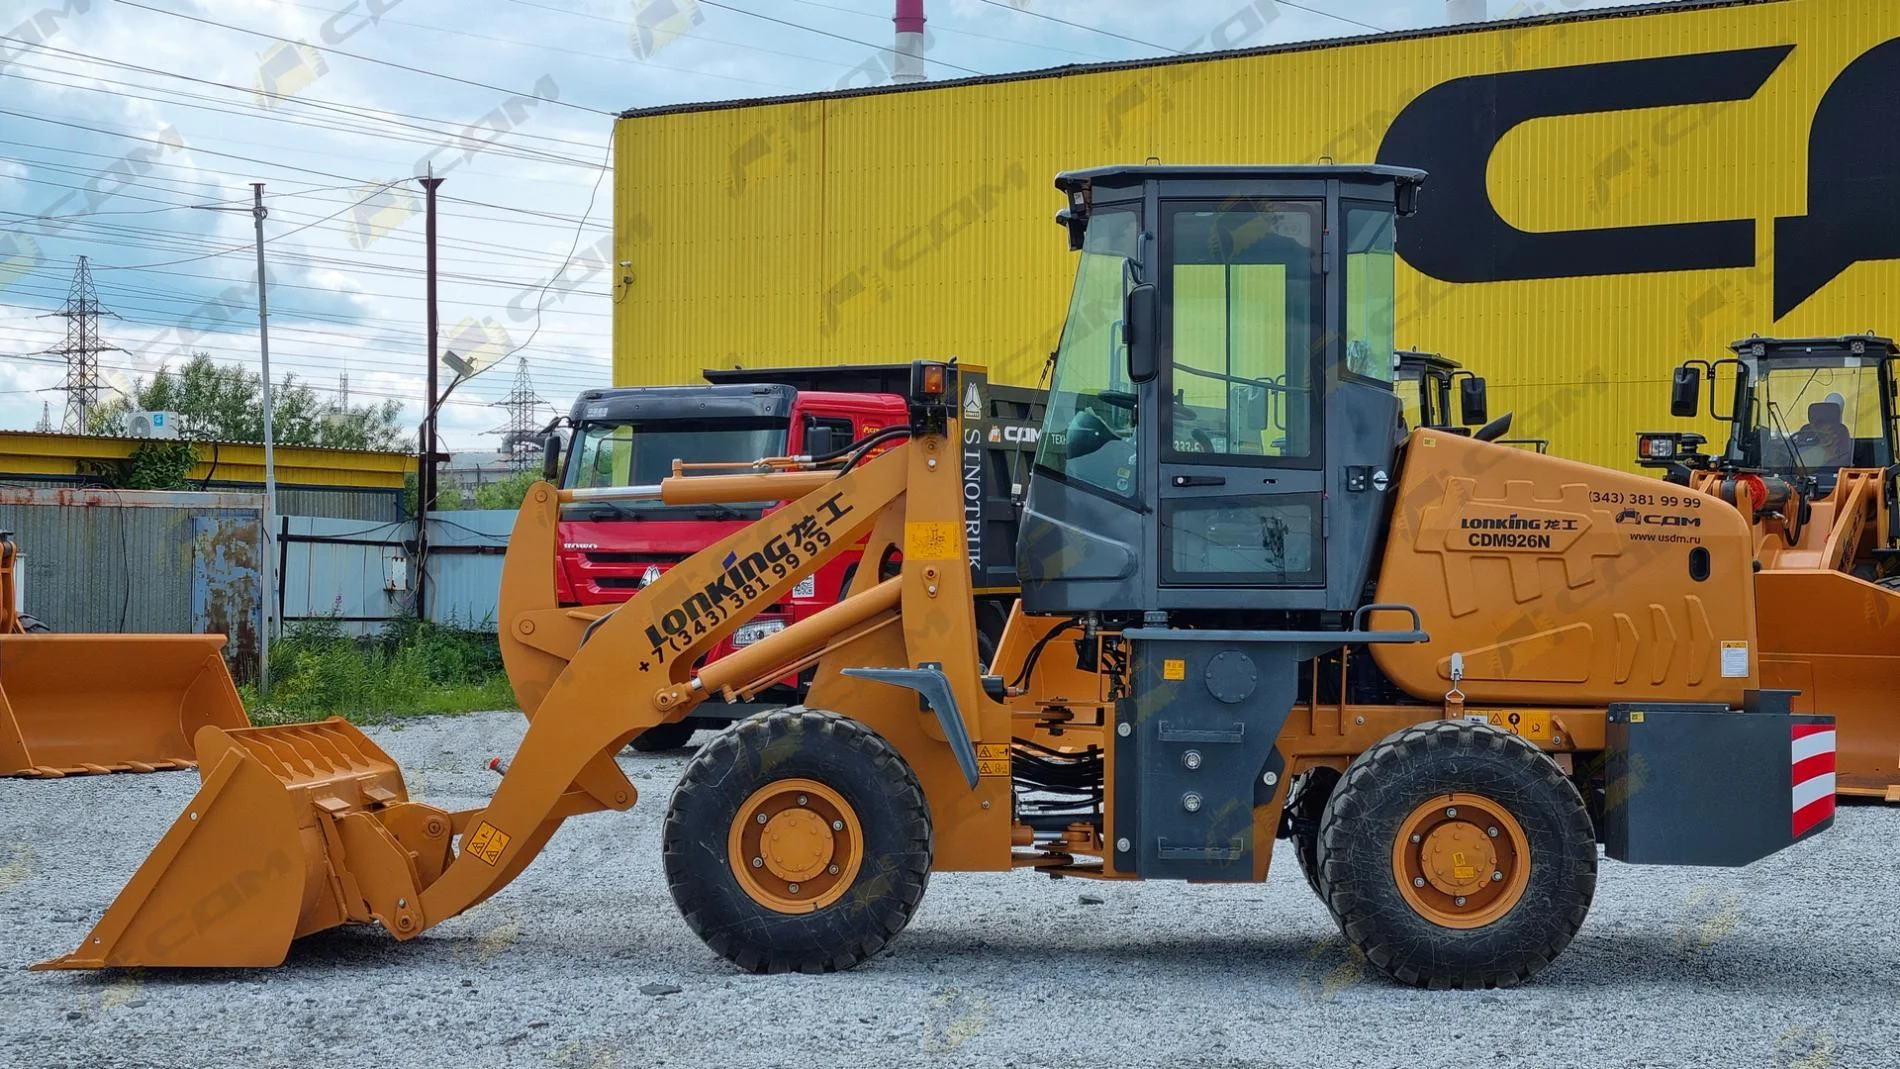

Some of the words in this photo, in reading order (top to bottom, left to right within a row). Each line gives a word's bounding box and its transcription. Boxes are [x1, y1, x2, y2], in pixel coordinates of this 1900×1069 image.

[1588, 491, 1624, 504] (343)
[1629, 494, 1654, 505] 381
[1660, 496, 1678, 507] 99
[1683, 497, 1701, 508] 99
[786, 491, 854, 548] 龙工
[1468, 533, 1550, 548] CDM926N
[729, 578, 771, 609] 381
[772, 554, 800, 579] 99
[803, 531, 831, 557] 99
